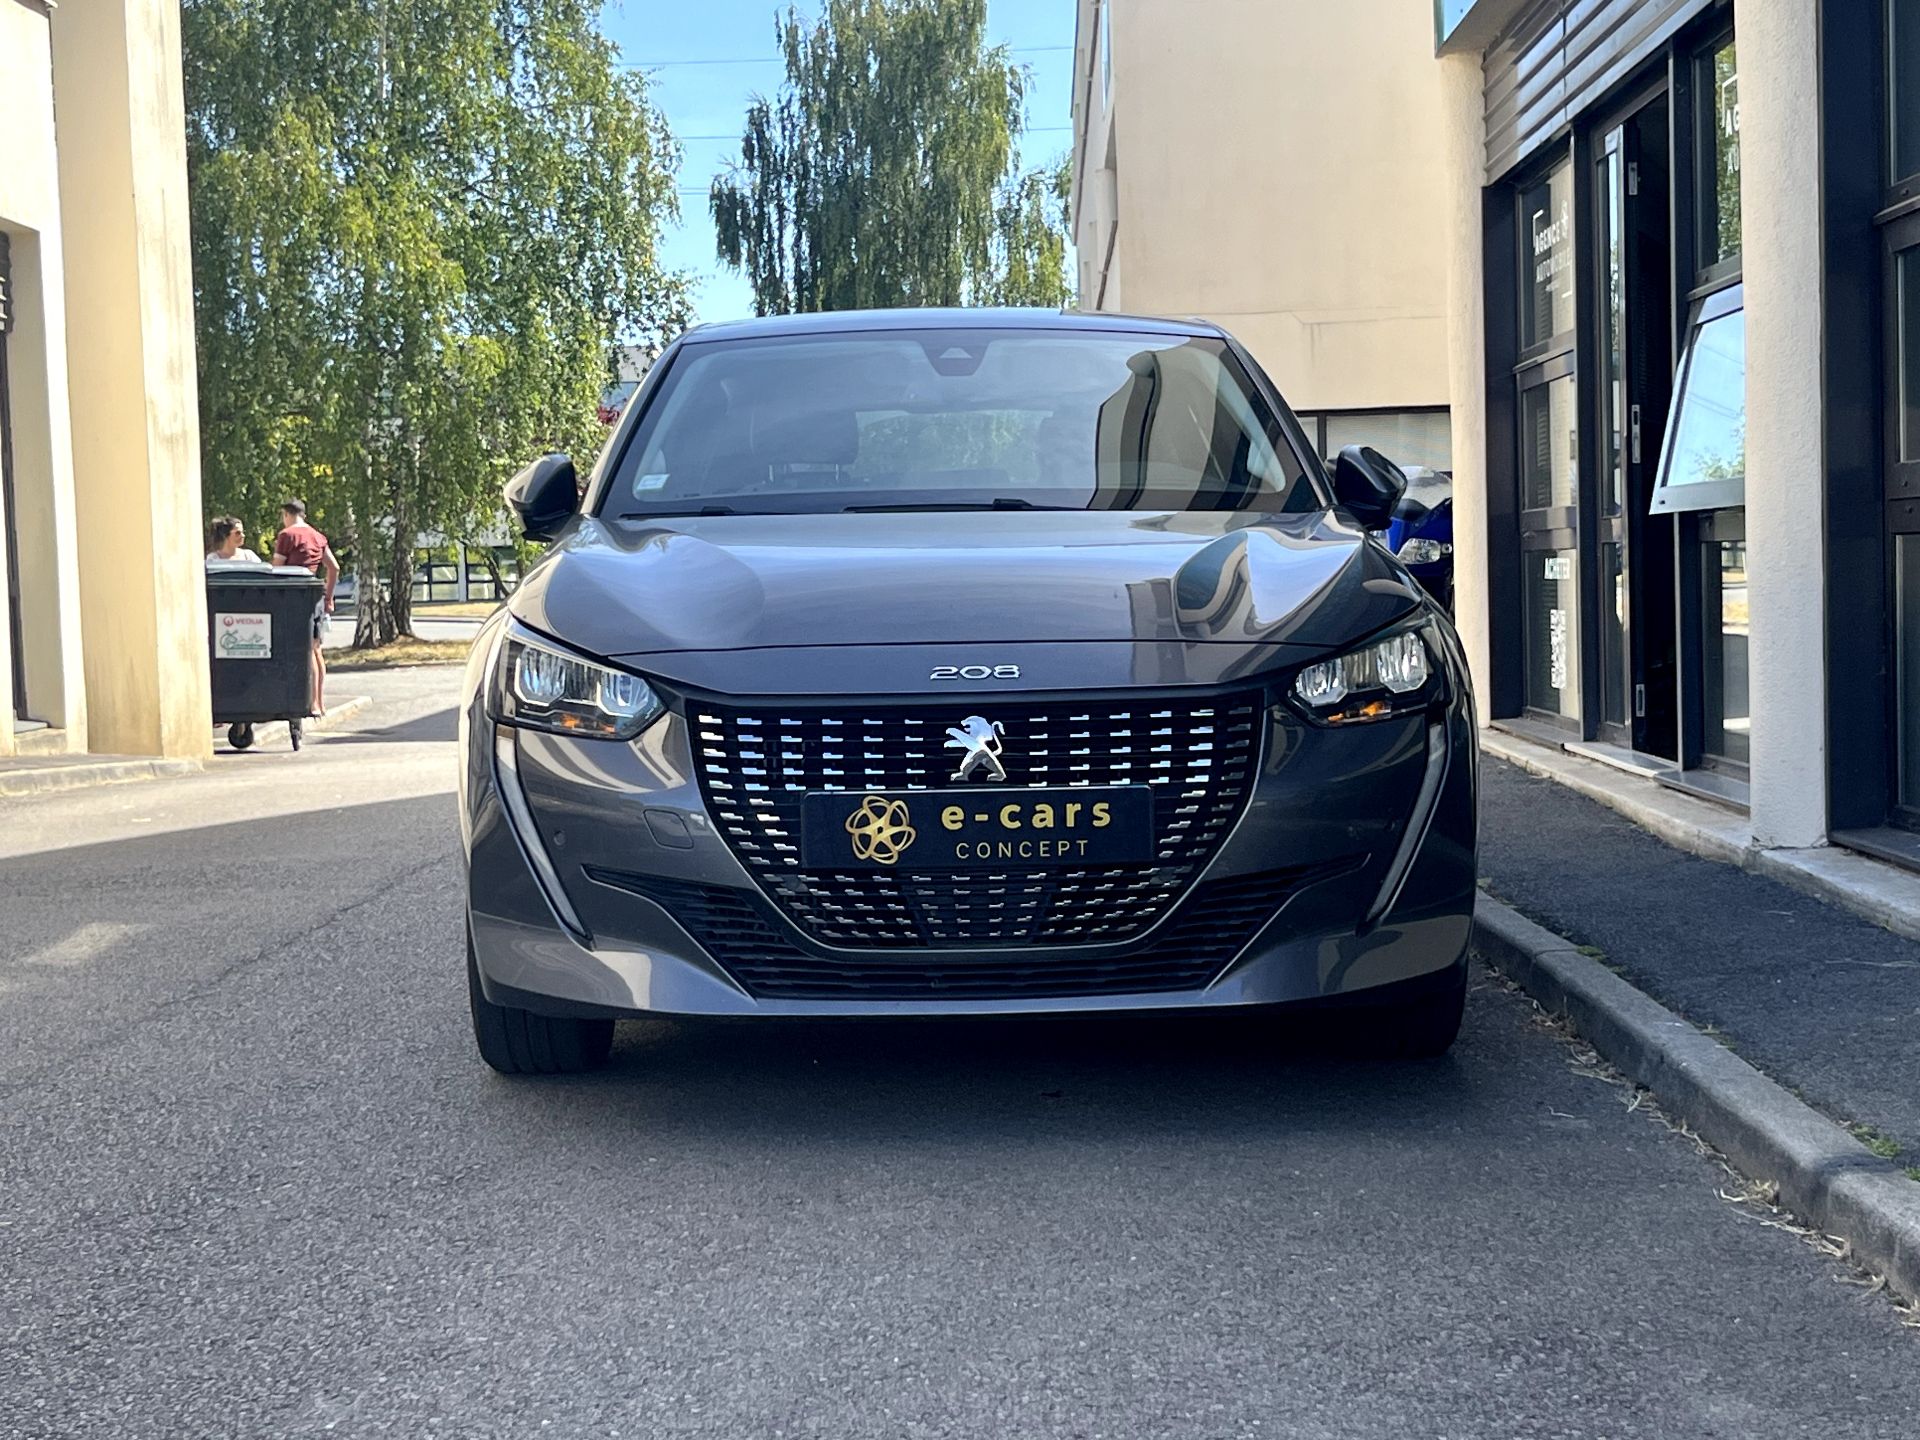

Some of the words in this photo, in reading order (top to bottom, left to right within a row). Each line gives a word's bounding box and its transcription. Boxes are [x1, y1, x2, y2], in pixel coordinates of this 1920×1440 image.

[1535, 221, 1560, 255] AGENCE
[1536, 247, 1571, 283] AUTOMOBILE
[930, 664, 1021, 680] 208
[940, 800, 1112, 831] e-cars
[956, 840, 1089, 859] CONCEPT
